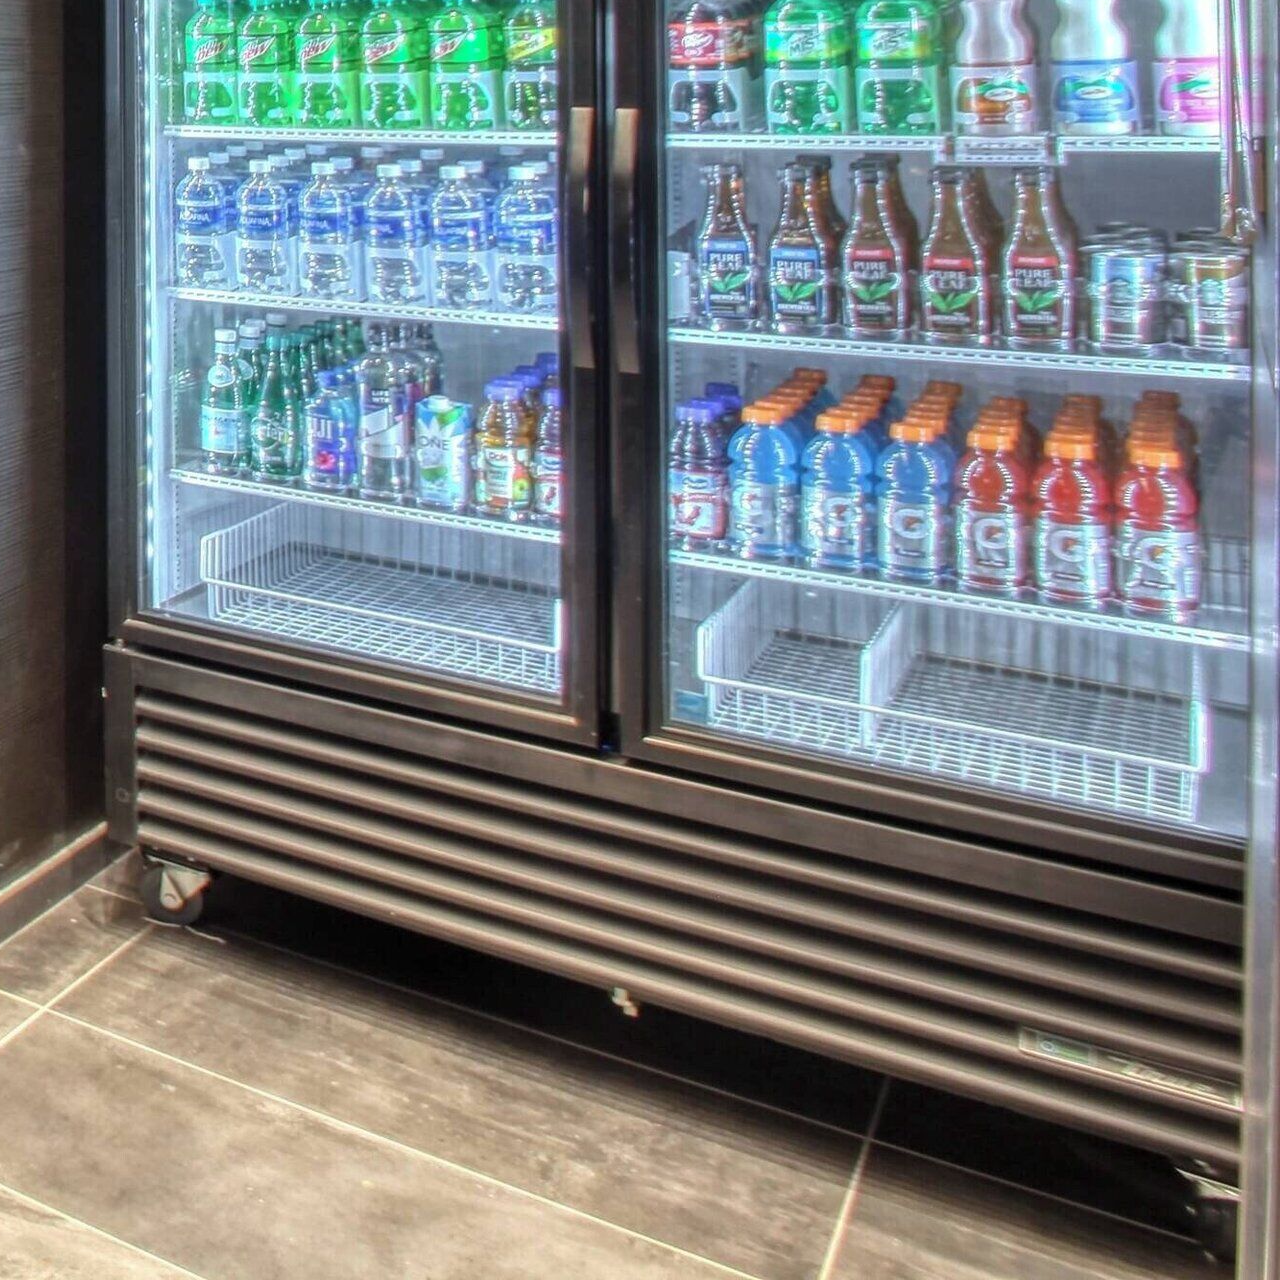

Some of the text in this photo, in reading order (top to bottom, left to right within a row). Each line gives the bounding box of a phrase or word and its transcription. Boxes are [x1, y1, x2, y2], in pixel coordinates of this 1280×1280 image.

[709, 252, 743, 263] PURE
[776, 259, 813, 271] PURE
[852, 261, 887, 271] PURE
[1014, 268, 1052, 279] PURE
[420, 435, 450, 451] ONE
